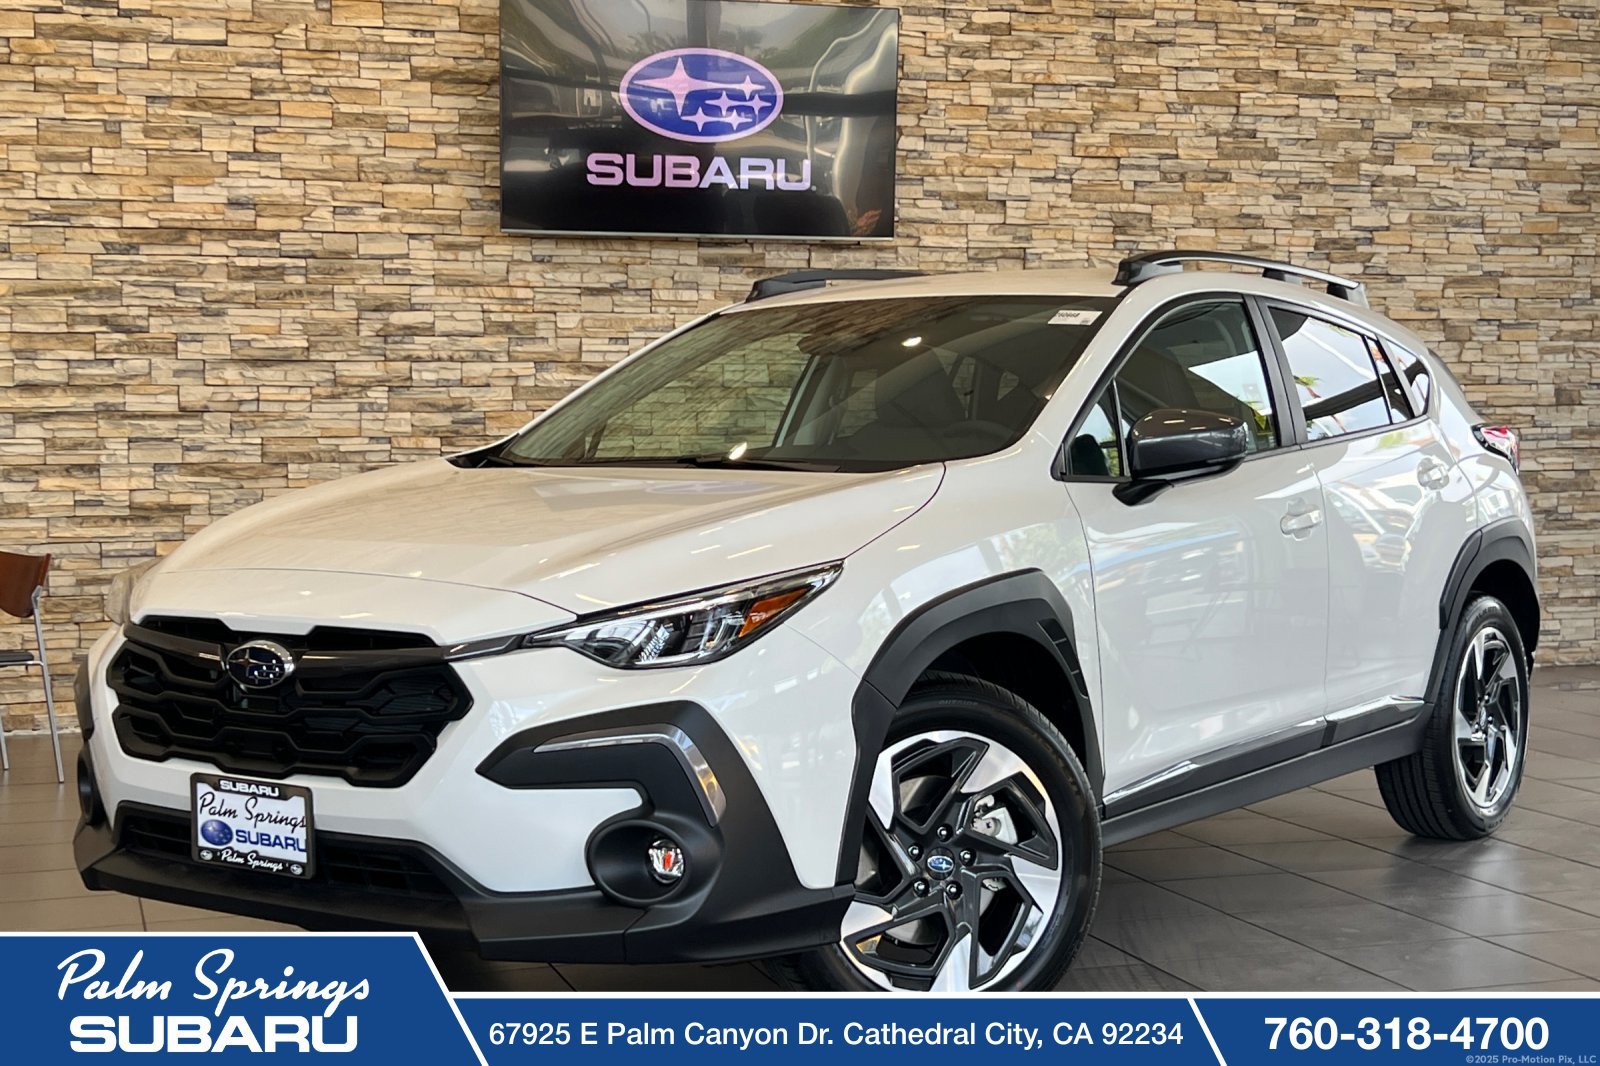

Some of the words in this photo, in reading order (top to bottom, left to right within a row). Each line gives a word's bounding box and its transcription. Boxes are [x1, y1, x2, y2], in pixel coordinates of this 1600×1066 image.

[586, 152, 811, 191] SUBARU
[219, 779, 279, 797] SUBARU
[199, 791, 239, 819] Palm
[244, 796, 306, 834] Springs
[221, 848, 245, 864] Palm
[247, 853, 283, 872] Springs
